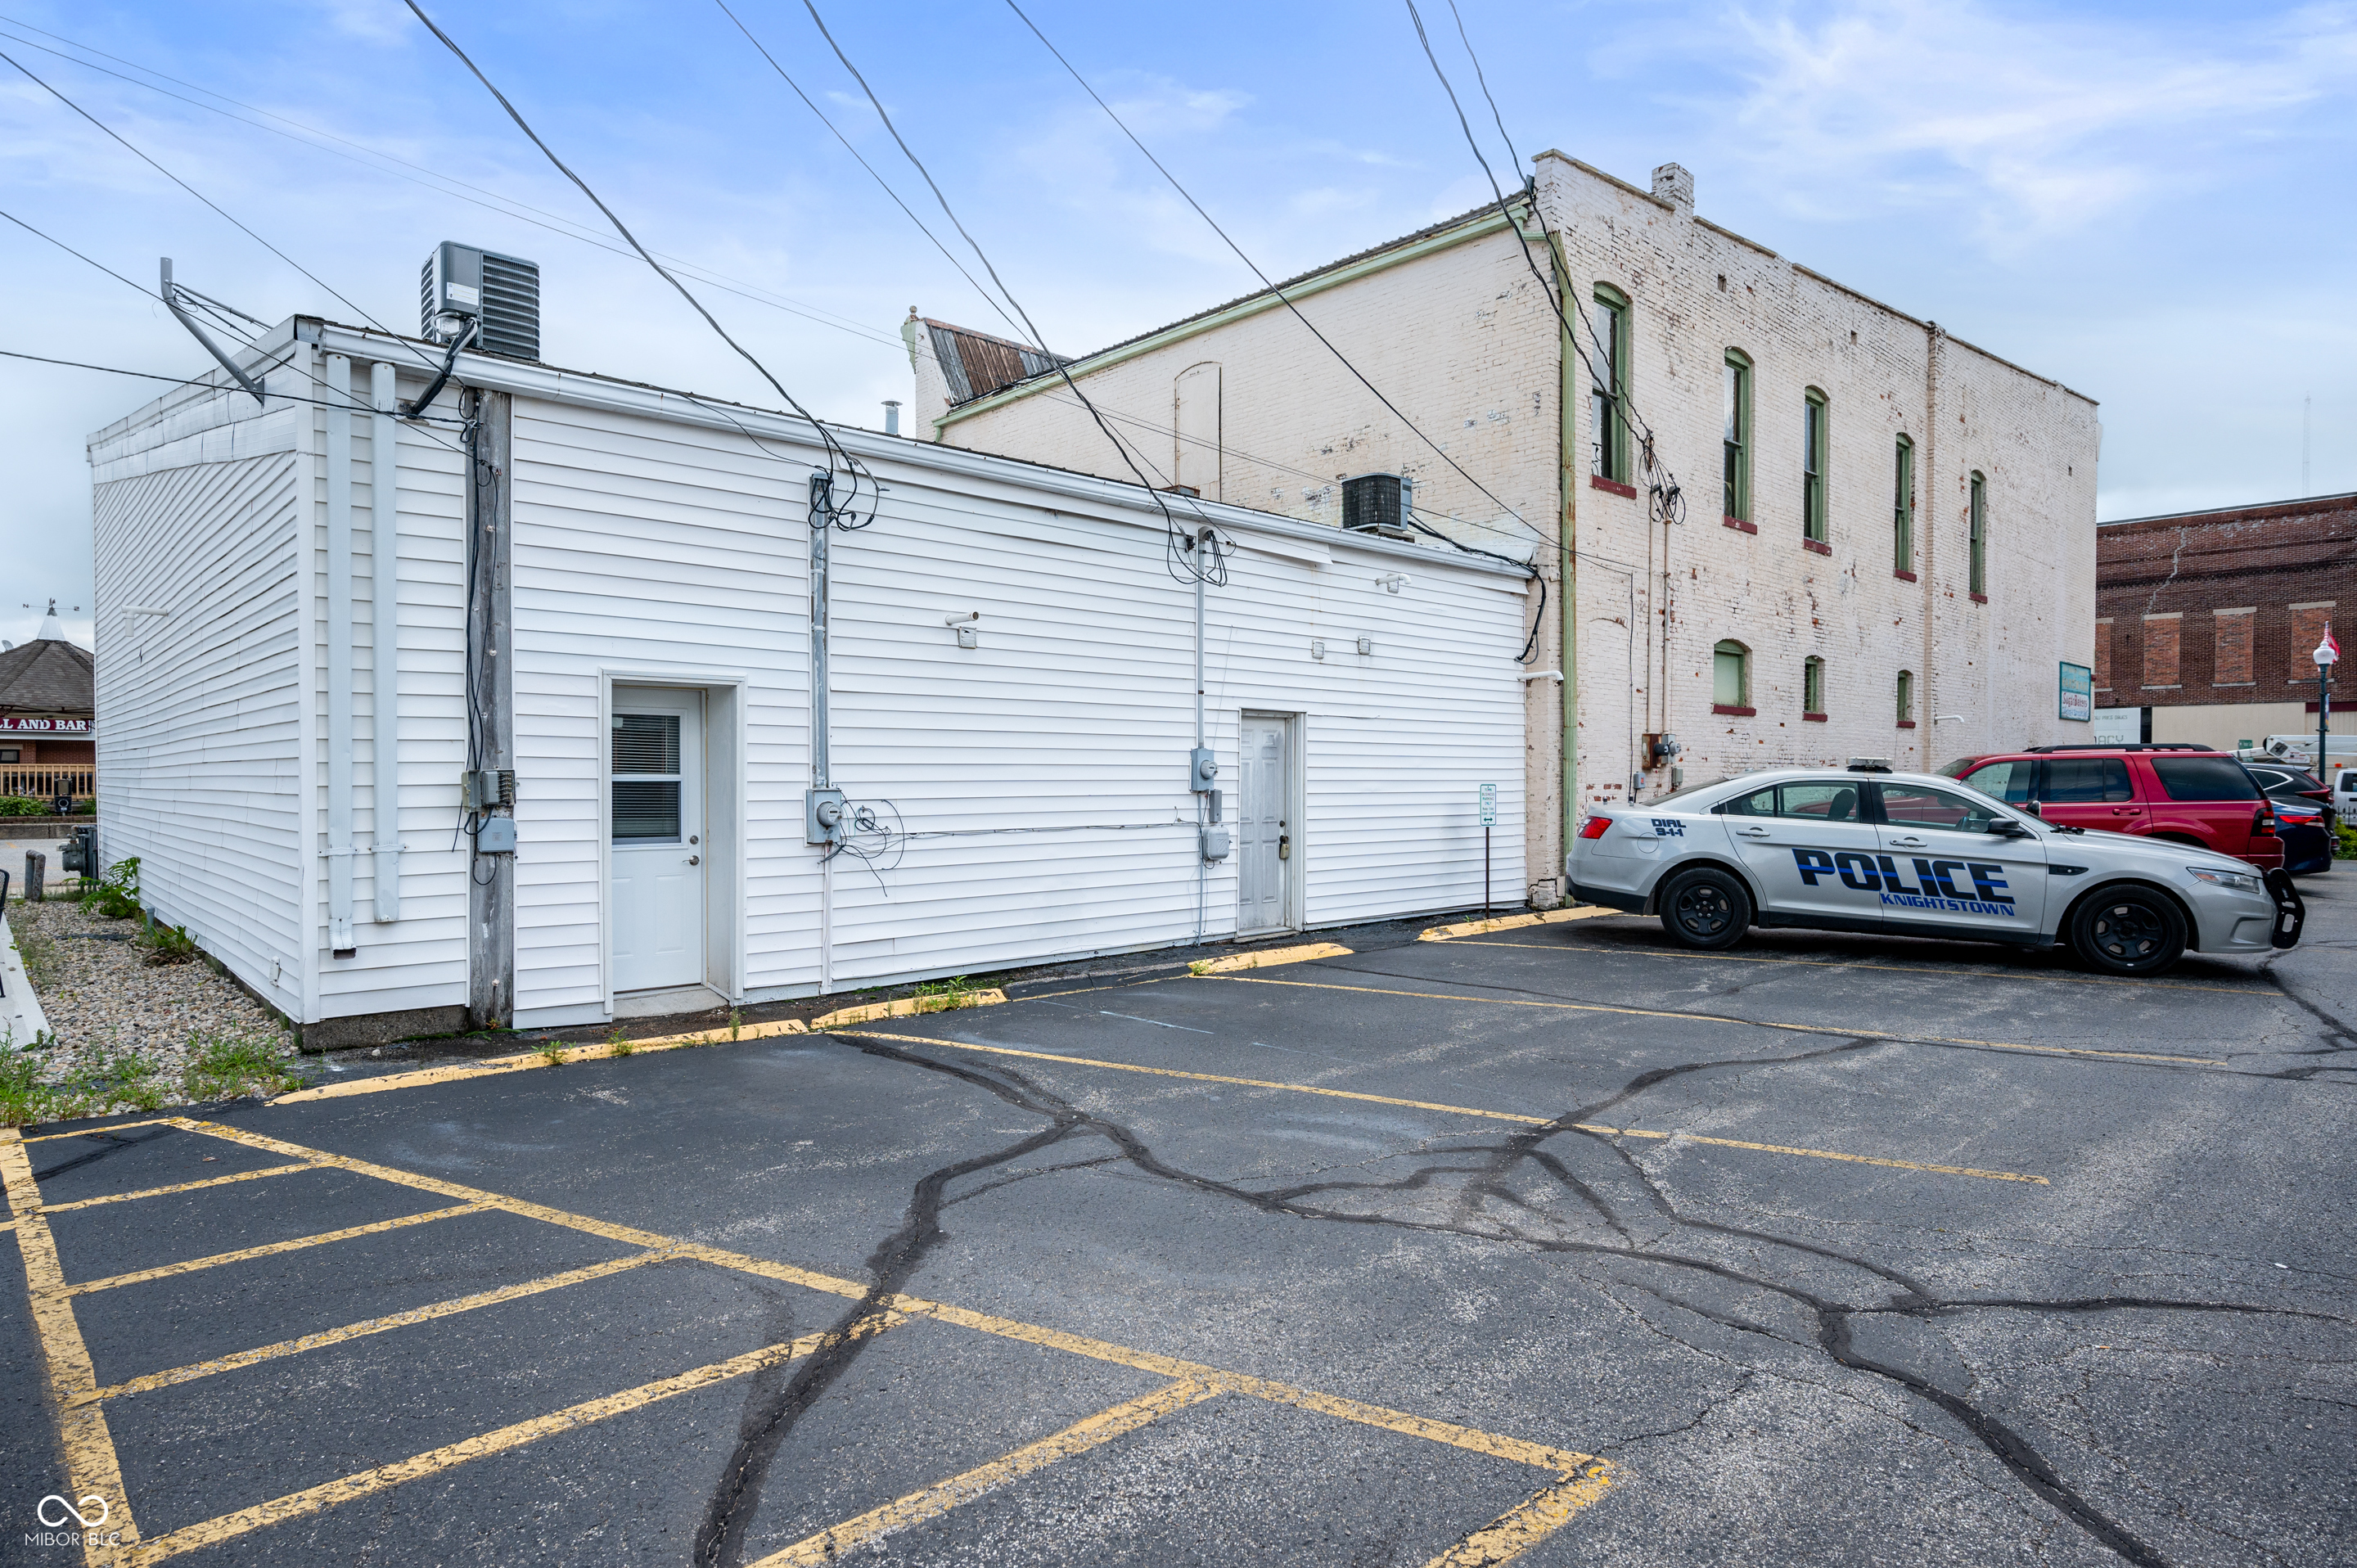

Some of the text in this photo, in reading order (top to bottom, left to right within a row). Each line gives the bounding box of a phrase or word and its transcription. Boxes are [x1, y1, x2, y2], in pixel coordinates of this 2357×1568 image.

[0, 719, 87, 730] L AND BAR
[1651, 819, 1687, 828] DIAL
[1656, 827, 1683, 836] 9-1-1
[1791, 849, 2016, 904] POLICE
[1880, 894, 2015, 916] KNIGHTSTOWN
